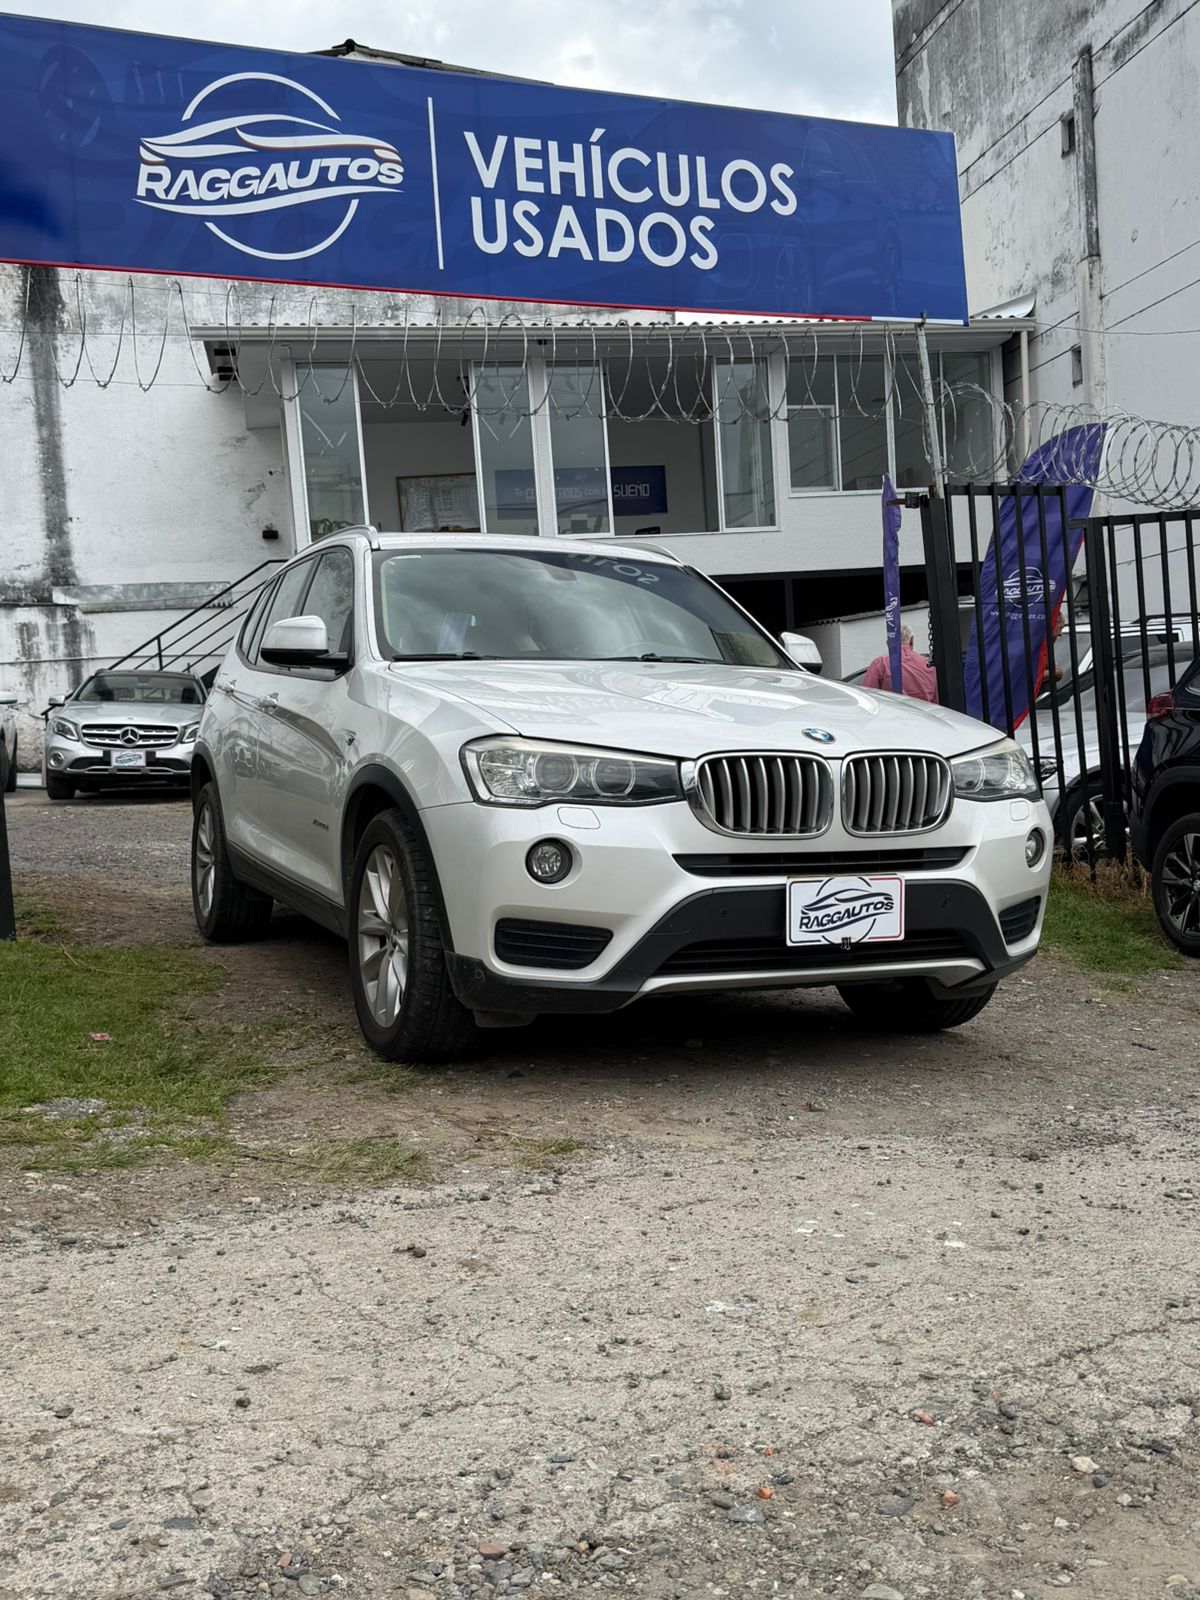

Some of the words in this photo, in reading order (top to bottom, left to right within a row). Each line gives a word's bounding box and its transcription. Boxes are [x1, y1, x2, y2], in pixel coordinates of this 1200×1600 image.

[137, 156, 405, 202] RAGGAUTOS
[464, 128, 798, 217] VEHÍCULOS
[471, 196, 719, 270] USADOS
[799, 900, 895, 930] RAGGAUTOS
